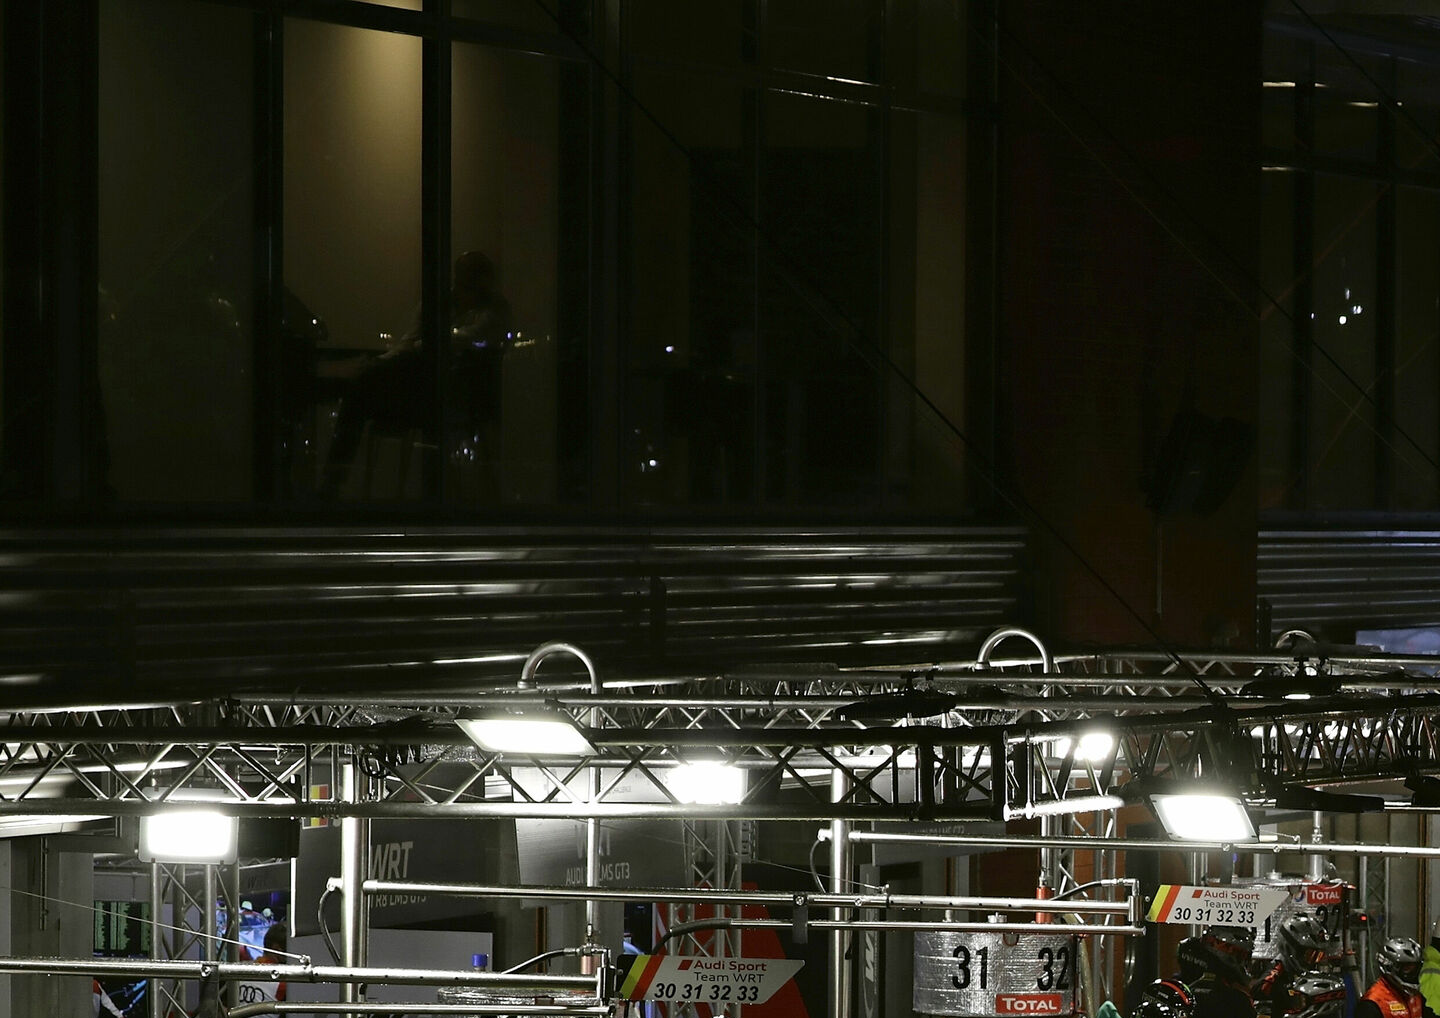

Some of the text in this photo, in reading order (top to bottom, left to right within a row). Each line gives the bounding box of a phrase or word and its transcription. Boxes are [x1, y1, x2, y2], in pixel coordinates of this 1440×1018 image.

[371, 841, 414, 881] WRT
[615, 862, 631, 880] GT3
[1204, 890, 1261, 902] Audi Sport
[1311, 889, 1340, 900] TOTAL
[1204, 901, 1258, 910] Team WRT
[1174, 907, 1254, 923] 30 31 32 33
[694, 961, 767, 973] Audi Sport
[951, 945, 1070, 991] 31 32
[694, 972, 764, 984] Team WRT
[654, 982, 759, 1001] 30 31 32 33
[1001, 997, 1058, 1012] TOTAL
